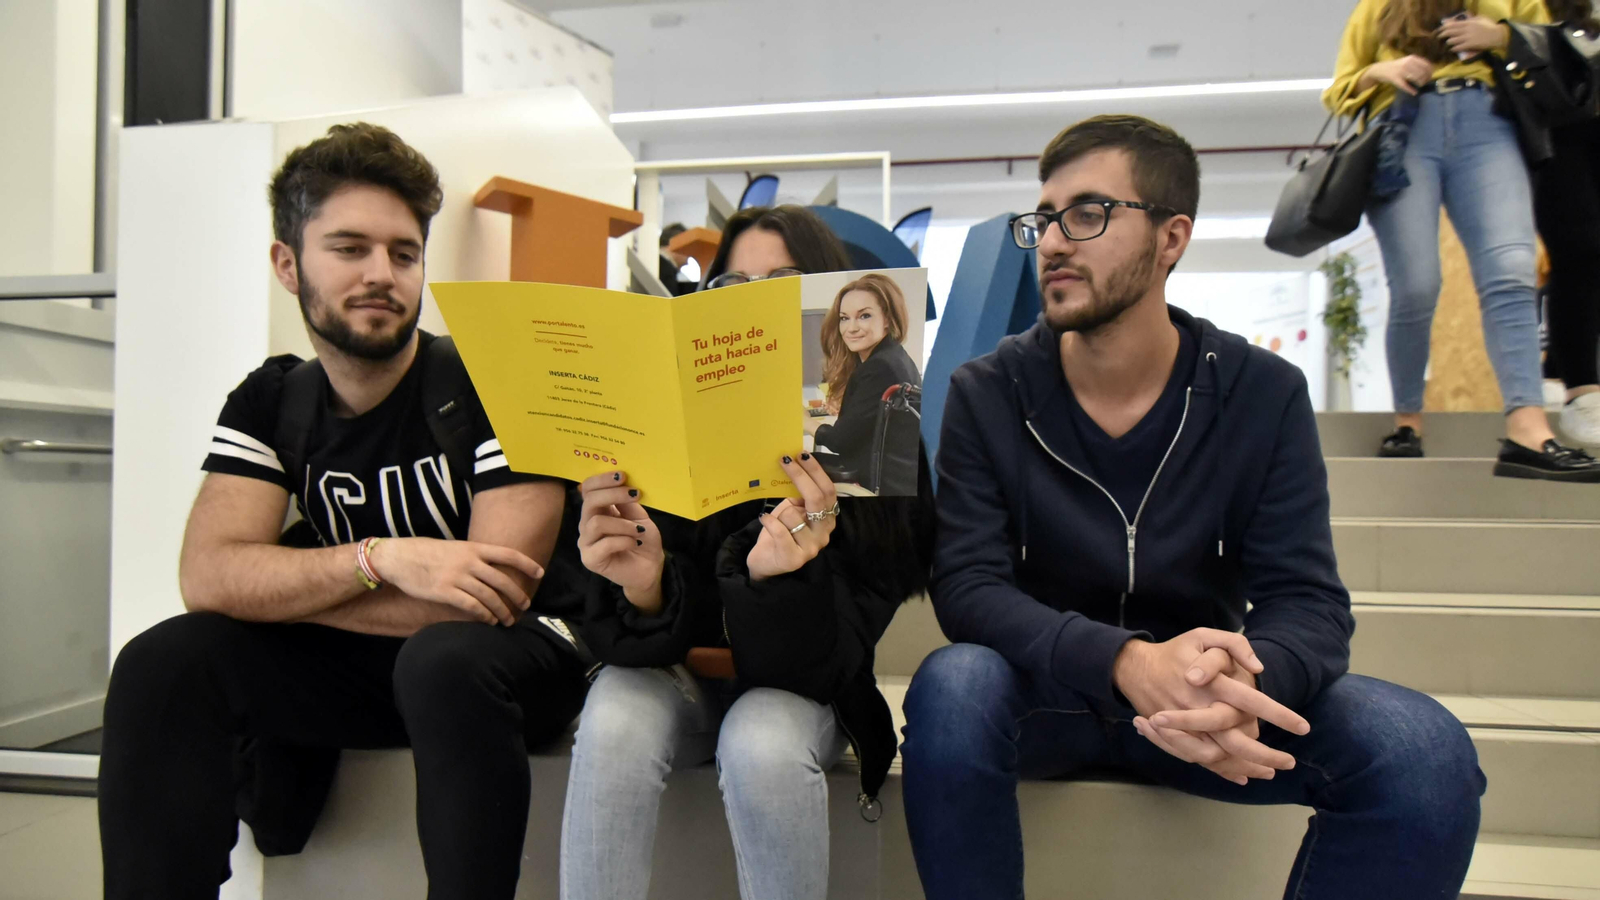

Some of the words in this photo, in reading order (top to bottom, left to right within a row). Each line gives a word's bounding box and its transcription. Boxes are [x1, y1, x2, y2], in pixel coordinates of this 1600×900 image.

[692, 338, 708, 351] Tu
[712, 331, 742, 346] hoja
[746, 326, 764, 339] de
[694, 353, 722, 368] ruta
[726, 343, 761, 360] hacia
[765, 338, 777, 352] el
[548, 370, 577, 379] INSERTA
[578, 373, 600, 383] CÁDIZ
[695, 363, 746, 383] empleo
